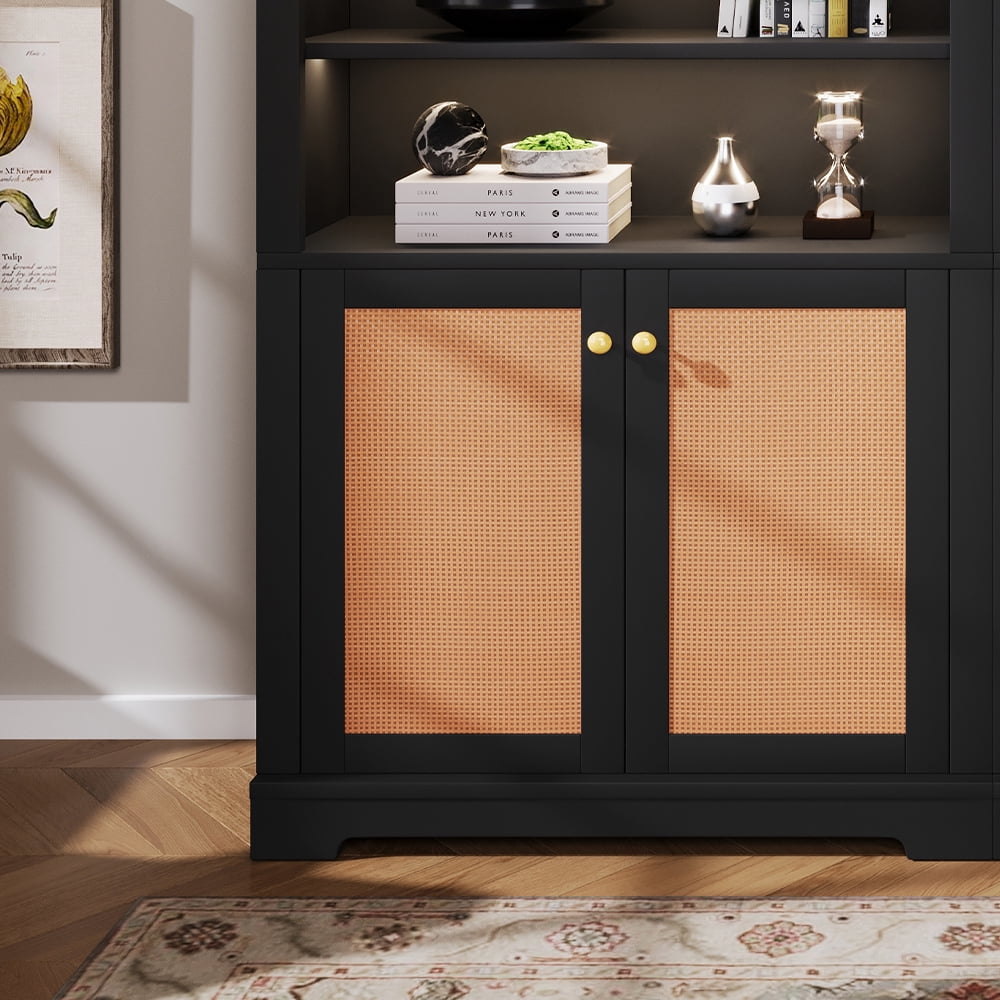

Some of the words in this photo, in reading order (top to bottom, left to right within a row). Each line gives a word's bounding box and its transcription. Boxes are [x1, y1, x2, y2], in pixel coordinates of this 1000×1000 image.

[487, 189, 513, 197] PARIS
[475, 210, 497, 218] NEW
[501, 210, 526, 218] YORK
[487, 231, 513, 239] PARIS
[2, 252, 23, 262] Tulip
